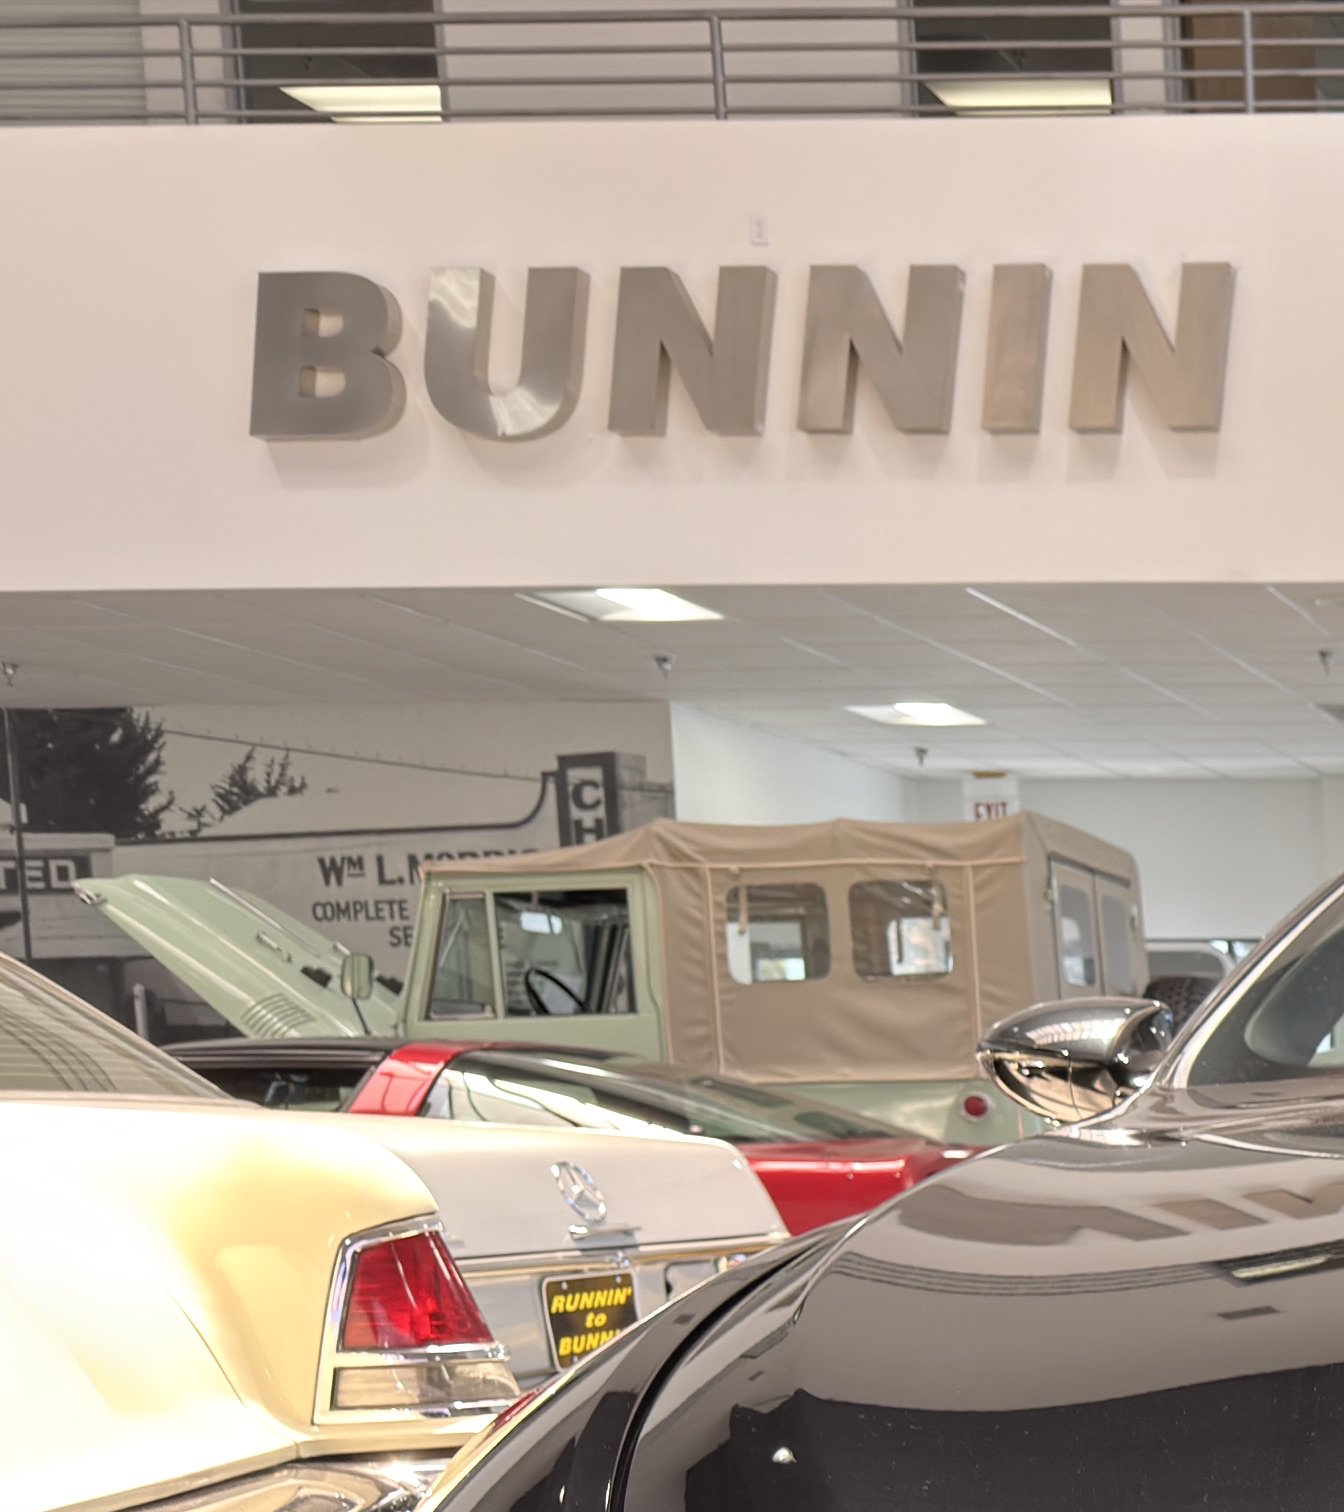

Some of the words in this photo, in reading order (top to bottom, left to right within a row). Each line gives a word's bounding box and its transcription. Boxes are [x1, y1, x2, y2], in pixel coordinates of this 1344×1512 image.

[250, 262, 1236, 443] BUNNIN
[311, 901, 410, 923] COMPLETE
[550, 1286, 633, 1315] RUNNIN'
[585, 1311, 608, 1329] to
